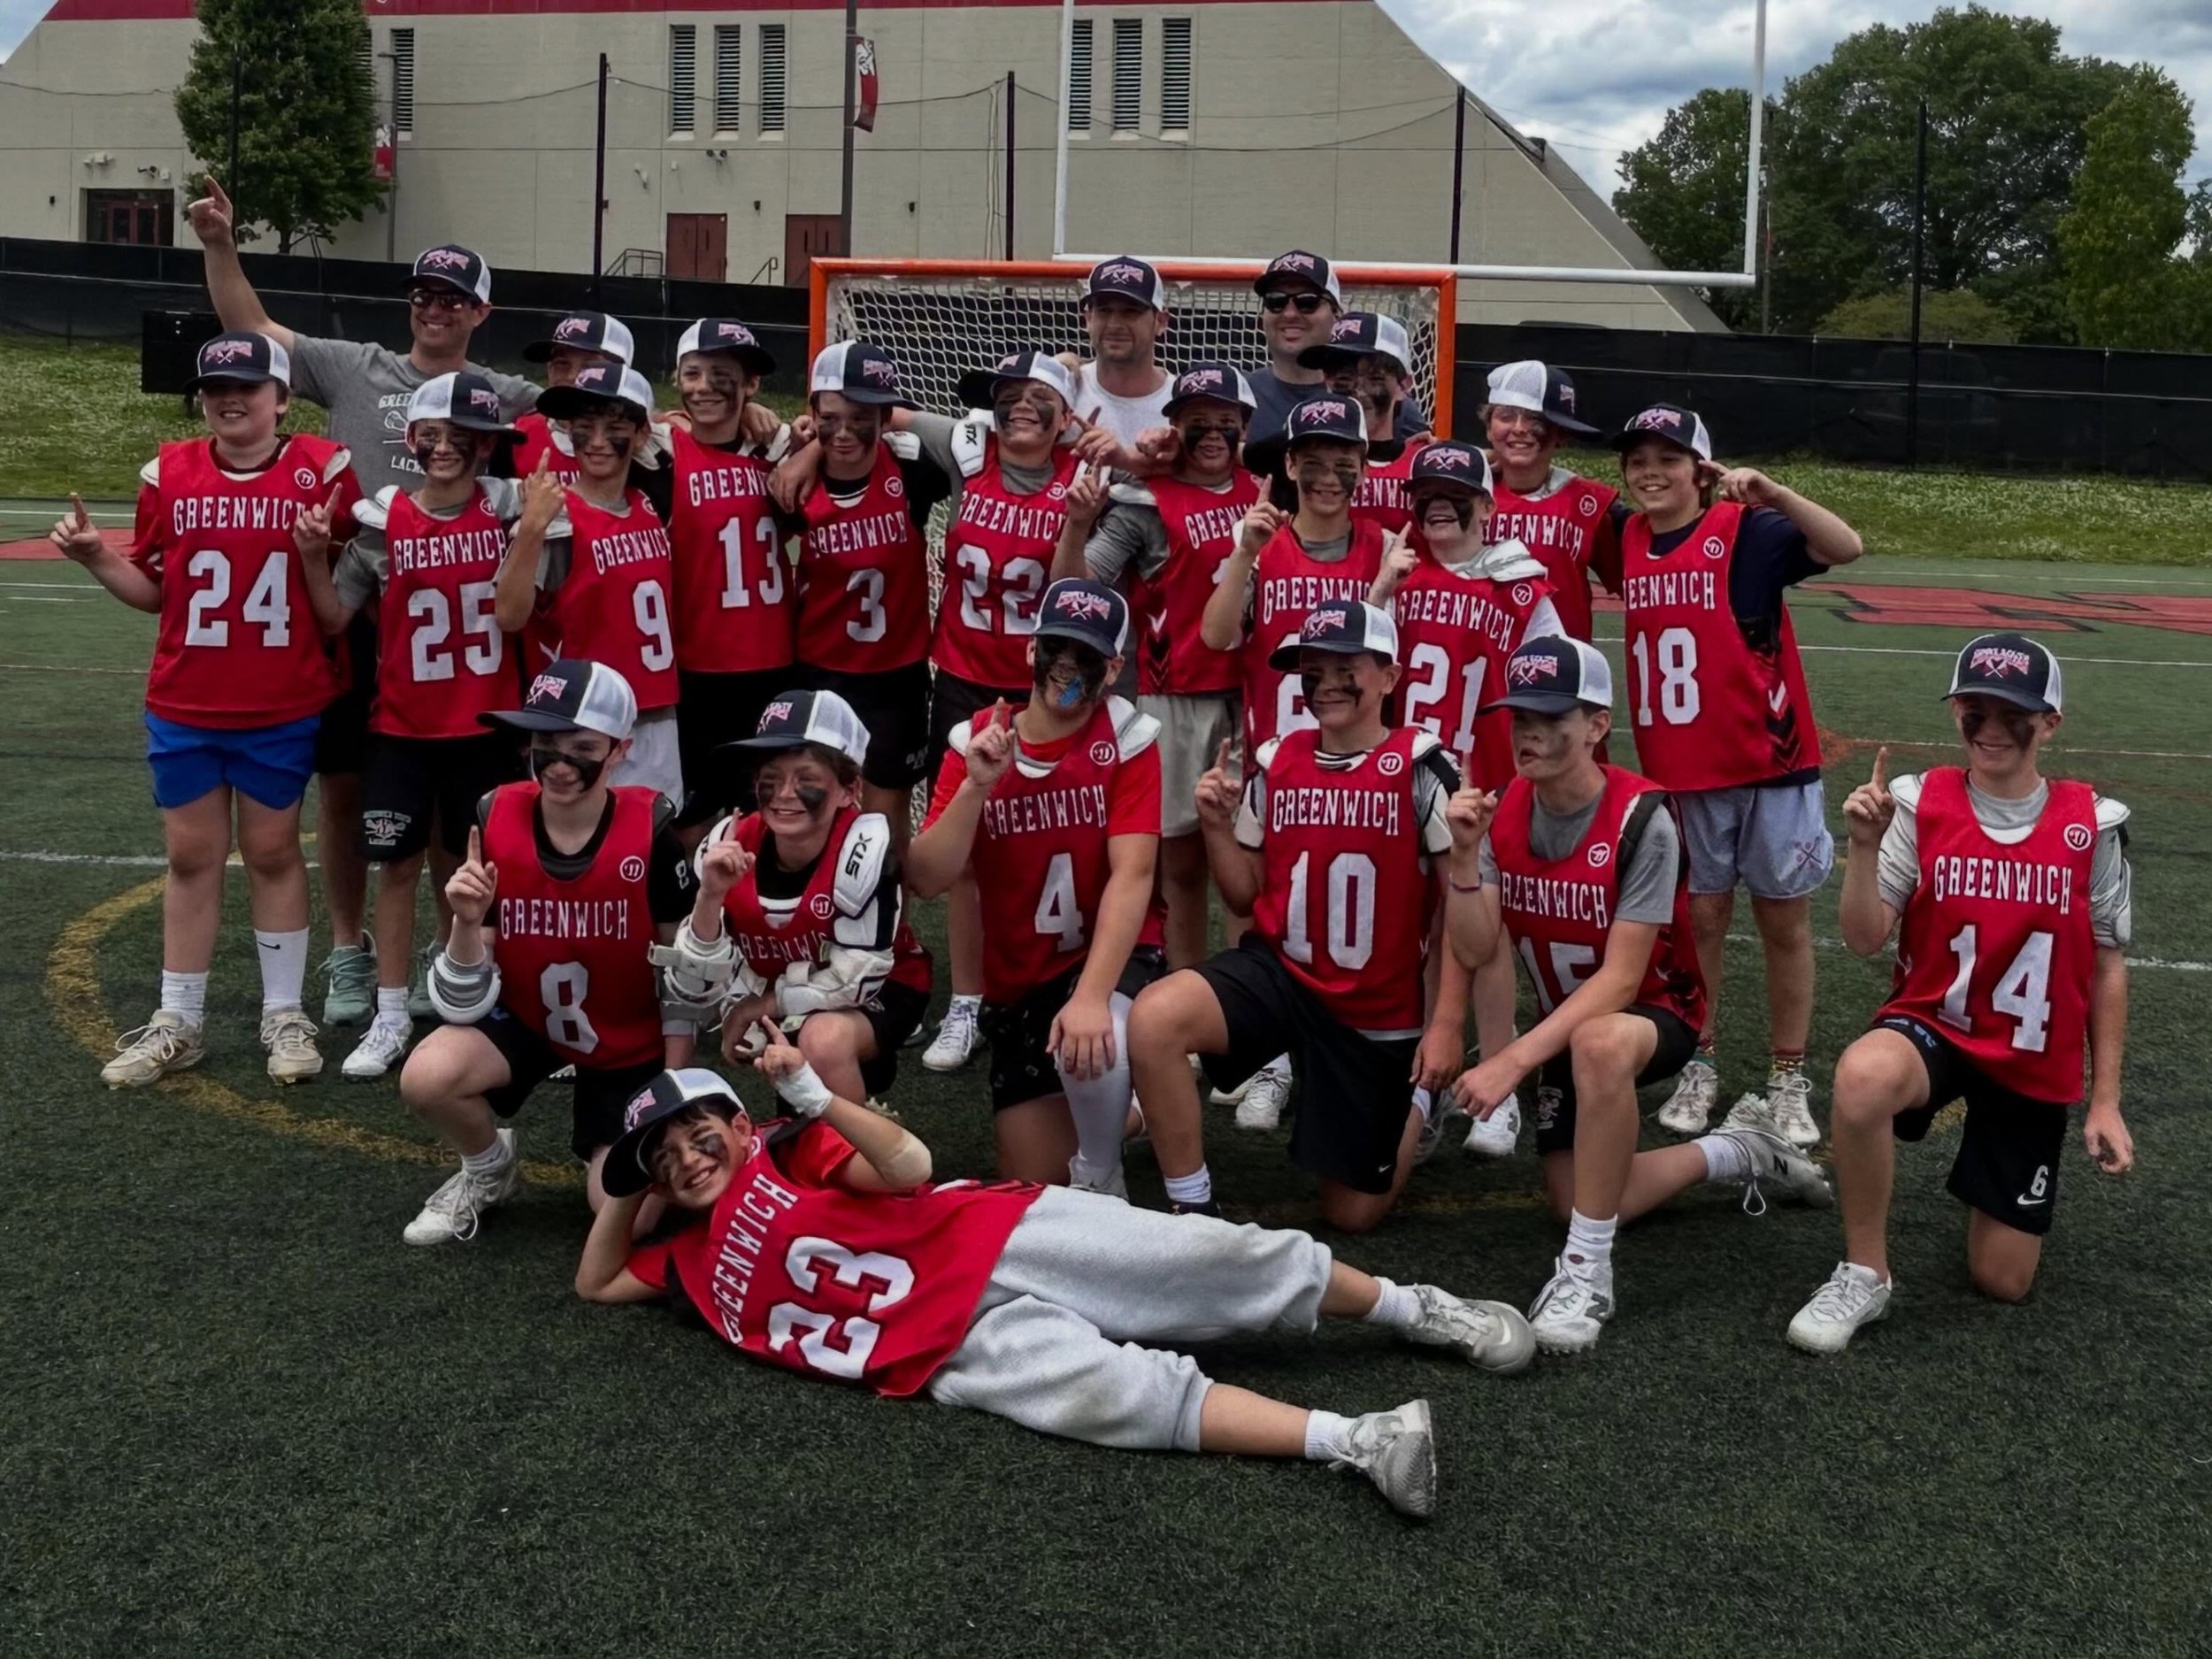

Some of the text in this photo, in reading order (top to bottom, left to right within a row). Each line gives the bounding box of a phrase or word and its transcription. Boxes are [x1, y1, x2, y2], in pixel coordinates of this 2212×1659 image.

[718, 516, 784, 609] 13
[1185, 503, 1254, 549] GREEN
[1483, 513, 1583, 561] EENWICH
[185, 549, 290, 647] 24
[408, 580, 503, 682] 25
[633, 580, 674, 672] 9
[846, 568, 887, 642] 3
[956, 543, 1045, 635] 22
[1398, 589, 1515, 652] GREENWICH
[1623, 572, 1716, 610] EENWICH
[1404, 642, 1487, 753] 21
[1632, 627, 1701, 726] 18
[844, 832, 872, 880] STX
[984, 784, 1107, 840] GREENWICH
[1272, 787, 1399, 836] GREENWICH
[501, 898, 627, 940] GREENWICH
[1034, 852, 1084, 952] 4
[1282, 850, 1376, 970] 10
[1934, 855, 2072, 915] GREENWICH
[541, 961, 599, 1054] 8
[1937, 925, 2054, 1052] 14
[768, 1236, 915, 1379] 23
